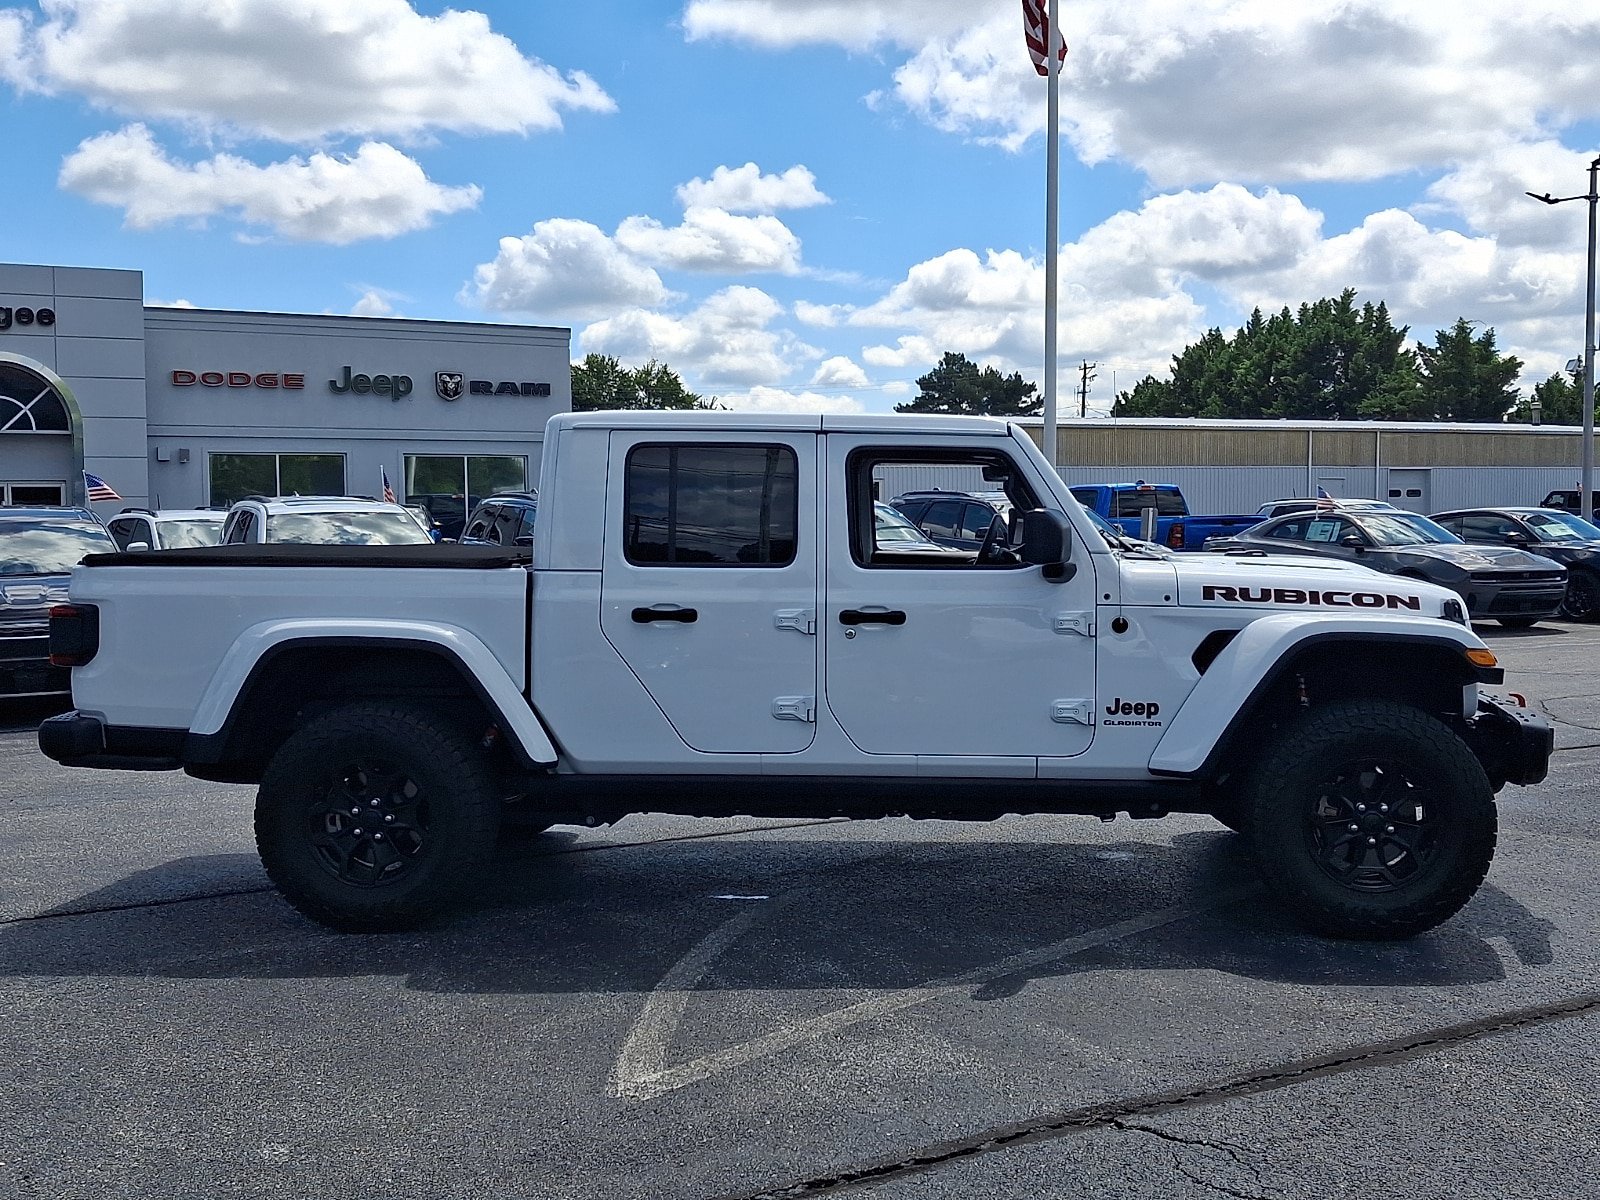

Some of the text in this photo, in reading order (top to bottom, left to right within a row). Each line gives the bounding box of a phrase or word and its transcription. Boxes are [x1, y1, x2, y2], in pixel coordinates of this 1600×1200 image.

[172, 370, 305, 388] DODGE
[329, 366, 413, 401] Jeep
[470, 380, 551, 397] RAM
[1203, 586, 1420, 610] RUBICON
[1105, 697, 1160, 719] Jeep
[1103, 719, 1162, 727] GLADIATOR
